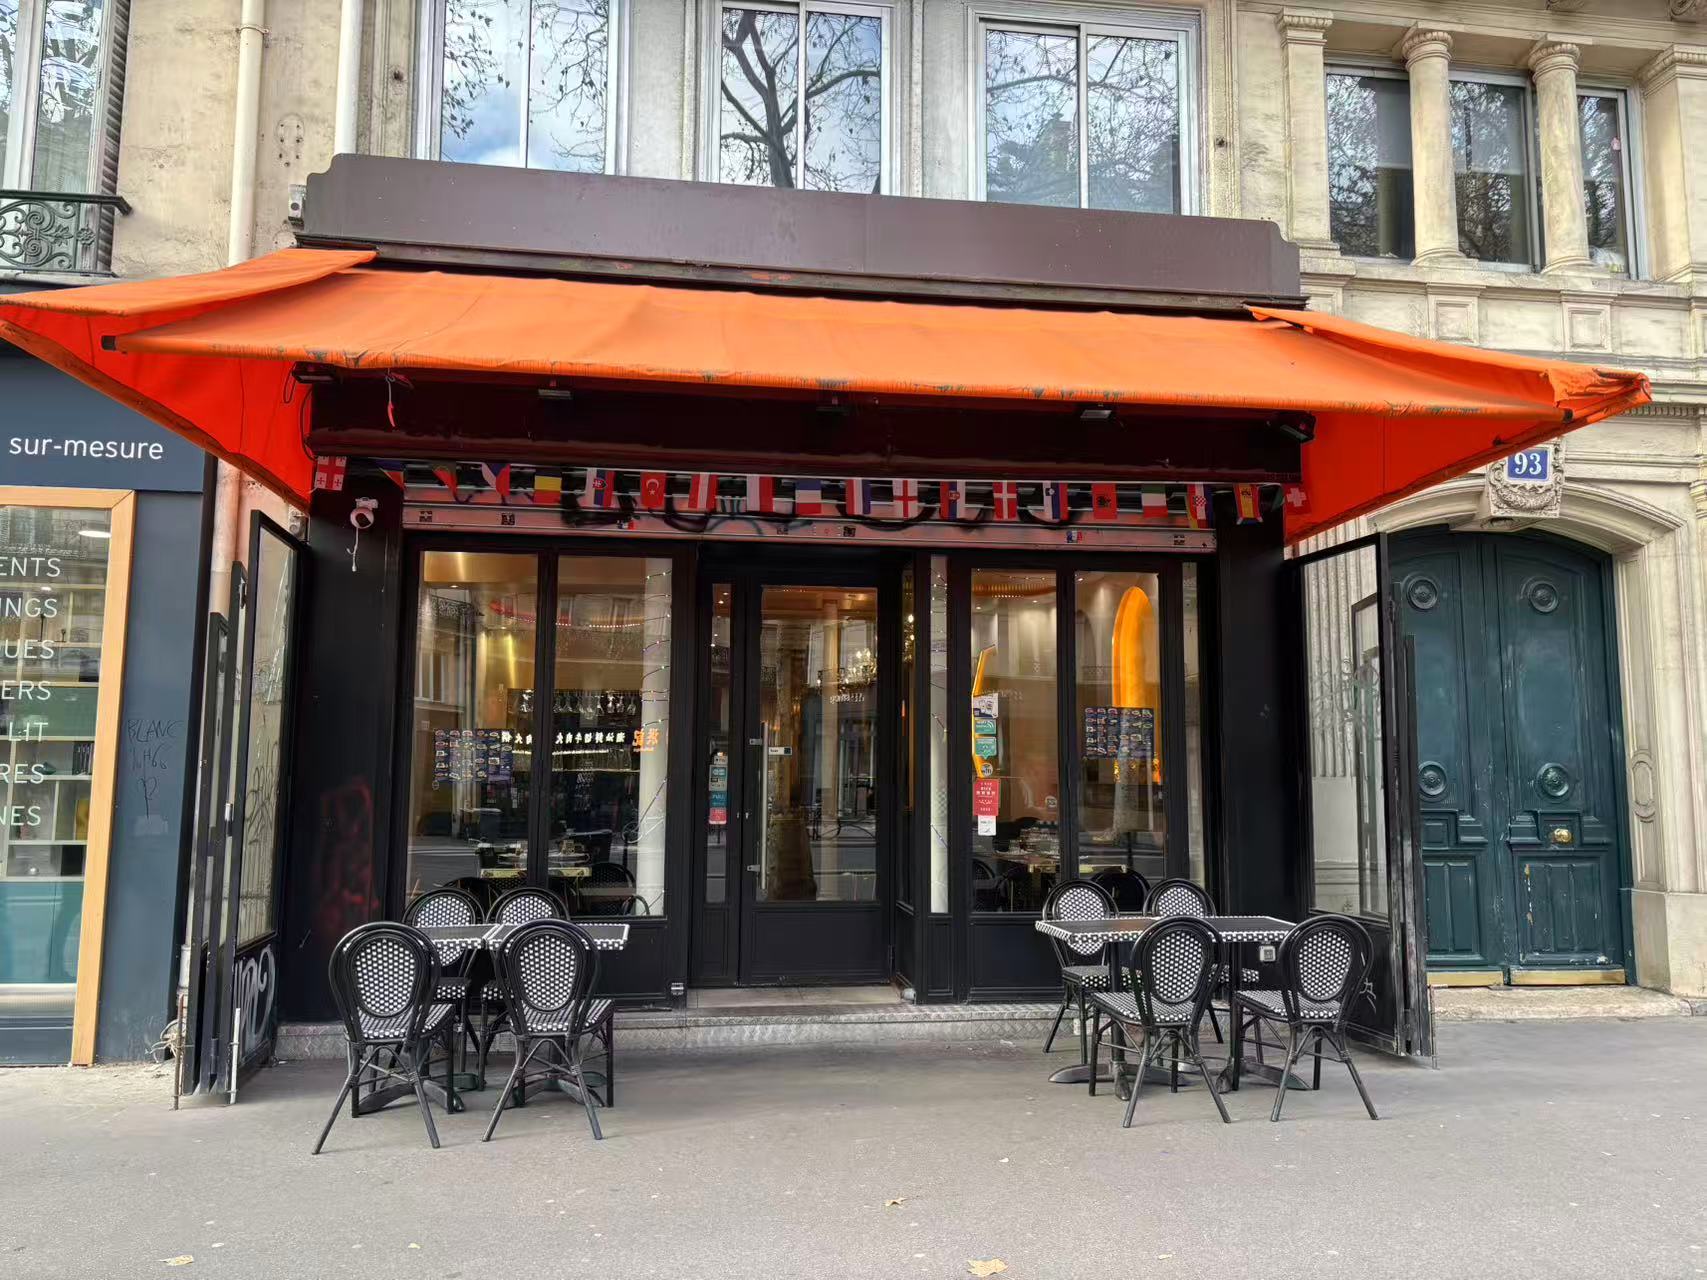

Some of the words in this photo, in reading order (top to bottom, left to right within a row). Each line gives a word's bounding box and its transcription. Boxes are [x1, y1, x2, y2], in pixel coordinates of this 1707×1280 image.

[9, 437, 164, 460] sur-mesure
[1514, 453, 1542, 475] 93
[0, 597, 58, 618] NGS
[4, 639, 55, 659] UES
[1, 680, 51, 700] ERS
[9, 722, 49, 742] LIT
